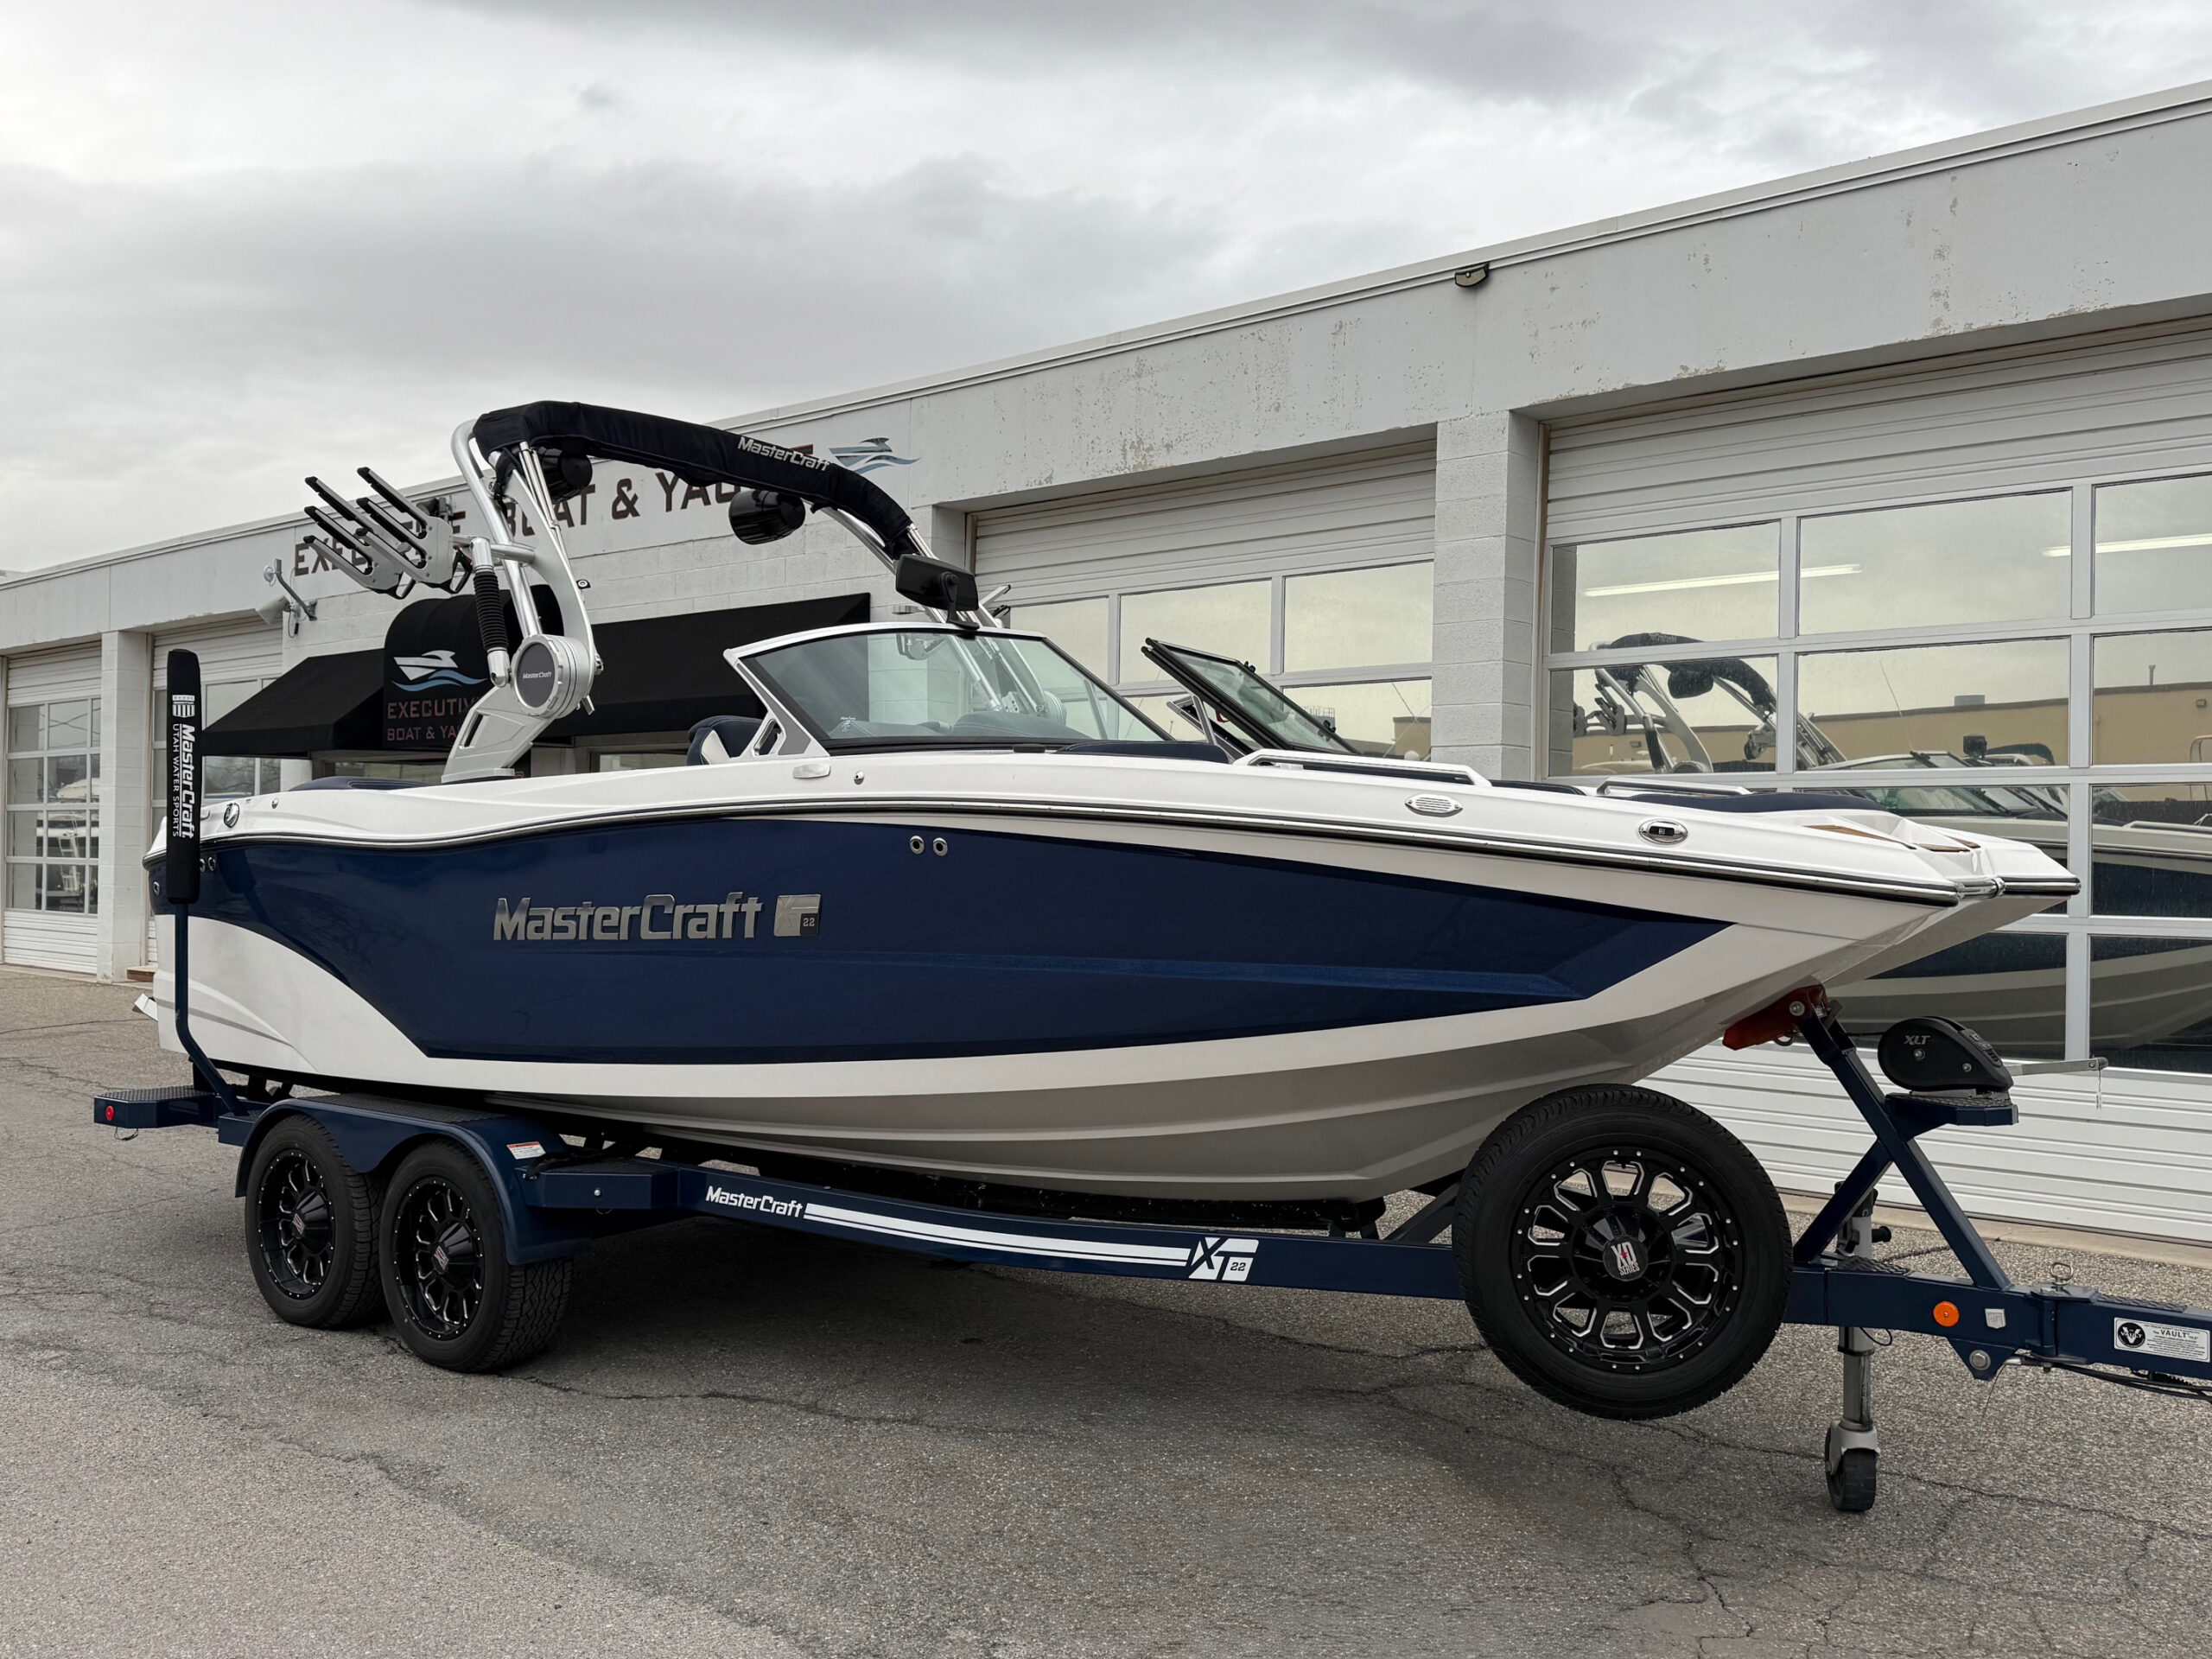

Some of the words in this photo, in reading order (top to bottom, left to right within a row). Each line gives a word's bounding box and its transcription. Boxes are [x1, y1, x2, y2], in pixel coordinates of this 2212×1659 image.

[737, 435, 830, 472] MasterCraft
[504, 483, 596, 537] BAT
[612, 478, 640, 520] &
[387, 697, 480, 719] EXECUTIV
[387, 727, 421, 741] BOAT
[426, 727, 435, 740] &
[181, 723, 195, 838] MasterCraft
[493, 892, 764, 941] MasterCraft
[803, 917, 815, 927] 22
[1904, 1035, 1930, 1046] XLT
[705, 1185, 804, 1217] MasterCraft
[1230, 1262, 1247, 1272] 22
[1611, 1241, 1637, 1270] XD
[1619, 1262, 1640, 1276] SERIES
[2160, 1328, 2187, 1338] VAULT
